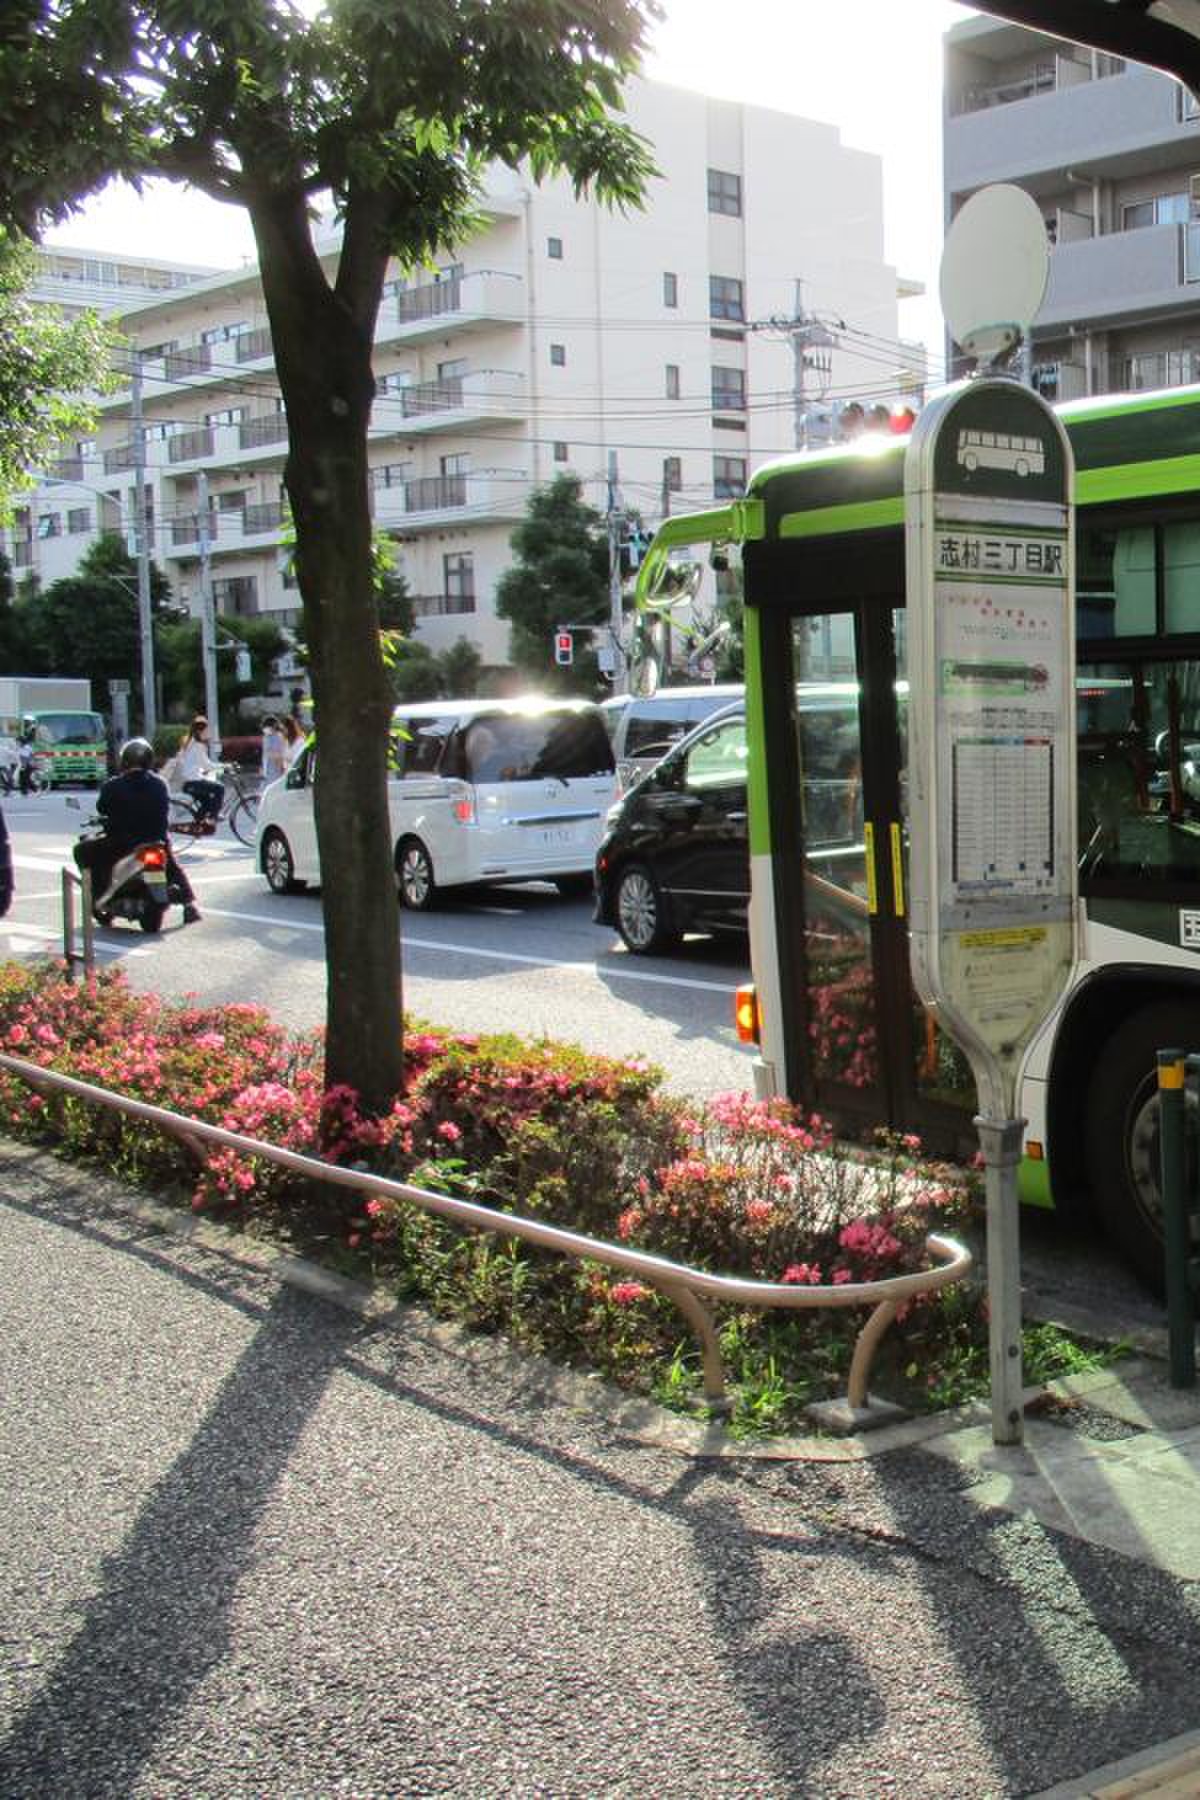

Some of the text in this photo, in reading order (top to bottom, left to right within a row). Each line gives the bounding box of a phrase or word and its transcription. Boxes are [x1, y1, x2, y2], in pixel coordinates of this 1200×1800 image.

[940, 538, 1063, 574] 志村三丁目駅
